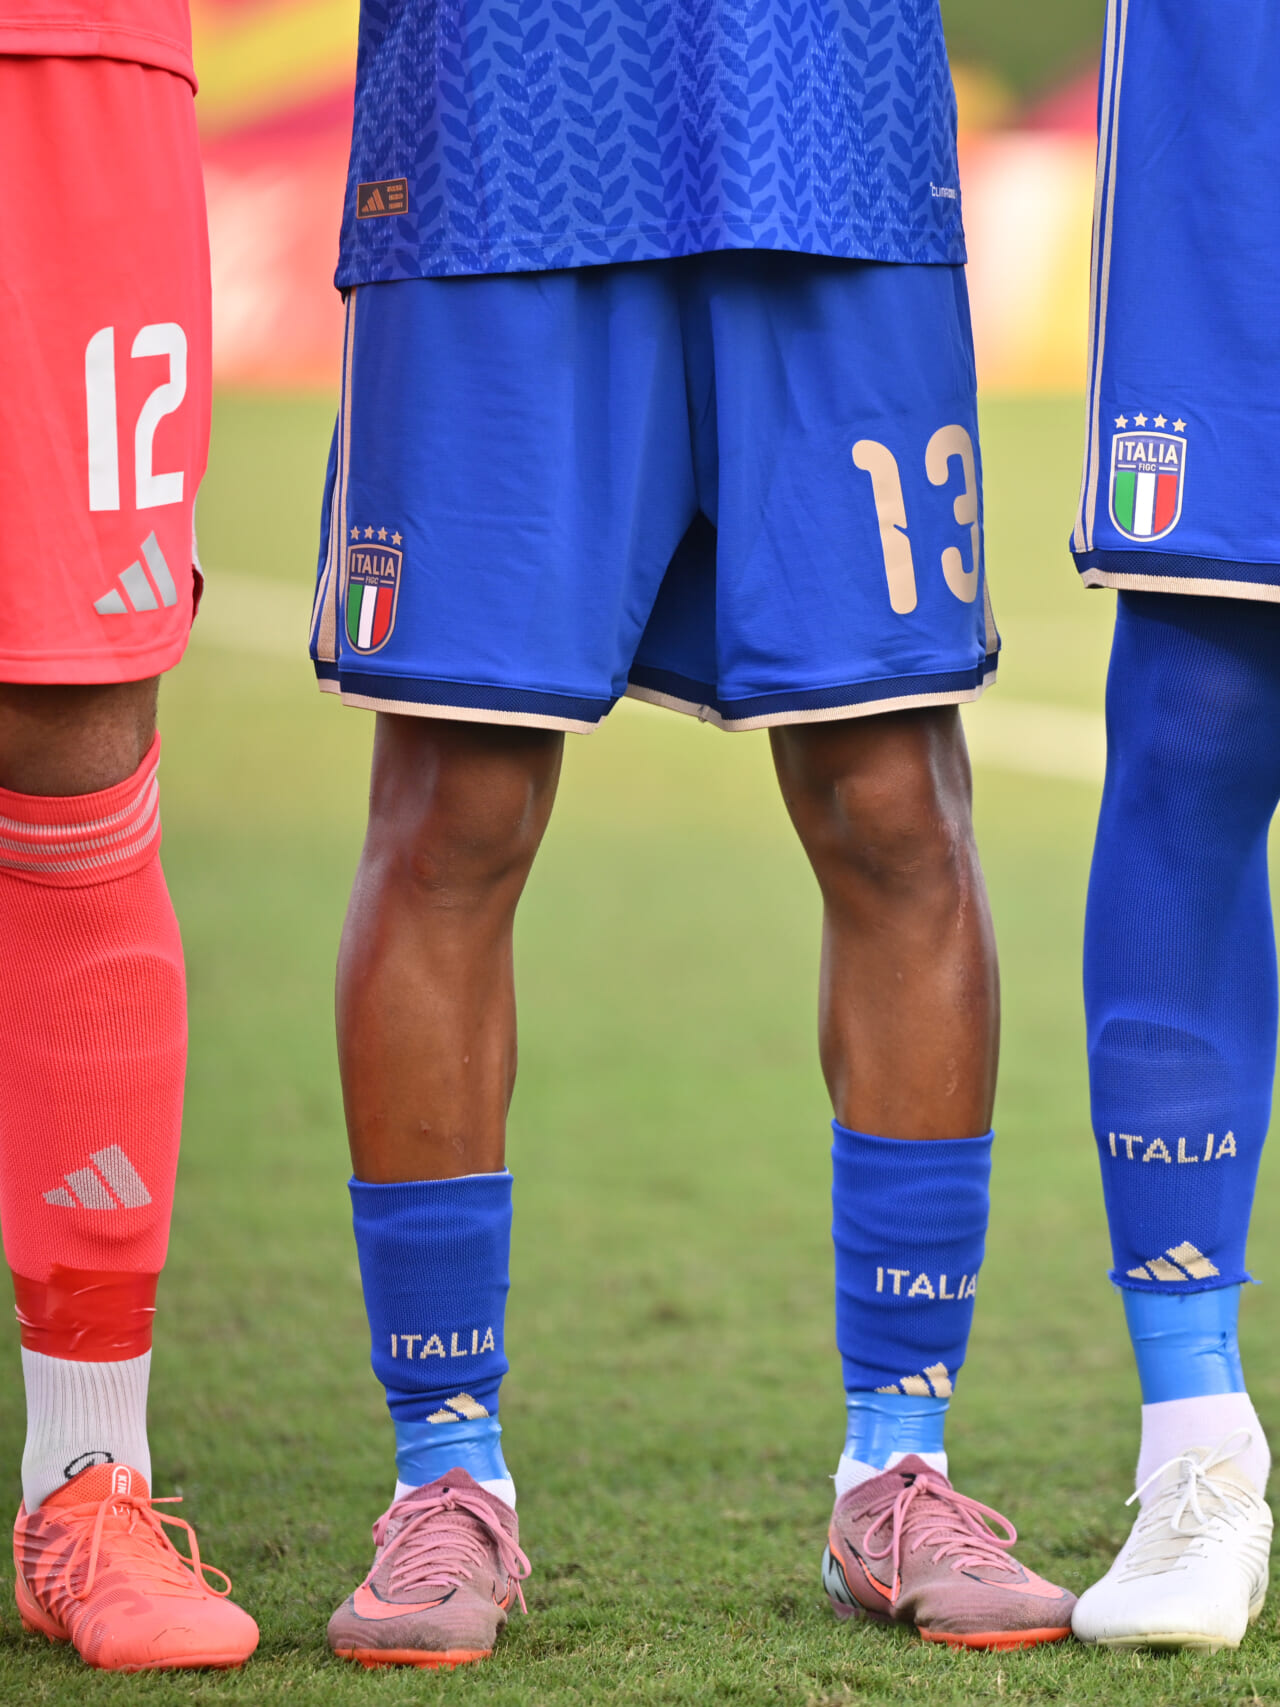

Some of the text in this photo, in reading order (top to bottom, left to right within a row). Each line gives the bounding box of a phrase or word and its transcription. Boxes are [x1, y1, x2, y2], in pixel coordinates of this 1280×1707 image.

[85, 322, 187, 512] 12
[1118, 441, 1178, 465] ITALIA
[1138, 463, 1157, 472] FIGC
[851, 424, 980, 614] 13
[351, 553, 395, 577] ITALIA
[1109, 1130, 1237, 1163] ITALIA
[876, 1266, 976, 1300] ITALIA
[391, 1327, 495, 1360] ITALIA
[117, 1474, 127, 1494] KIN
